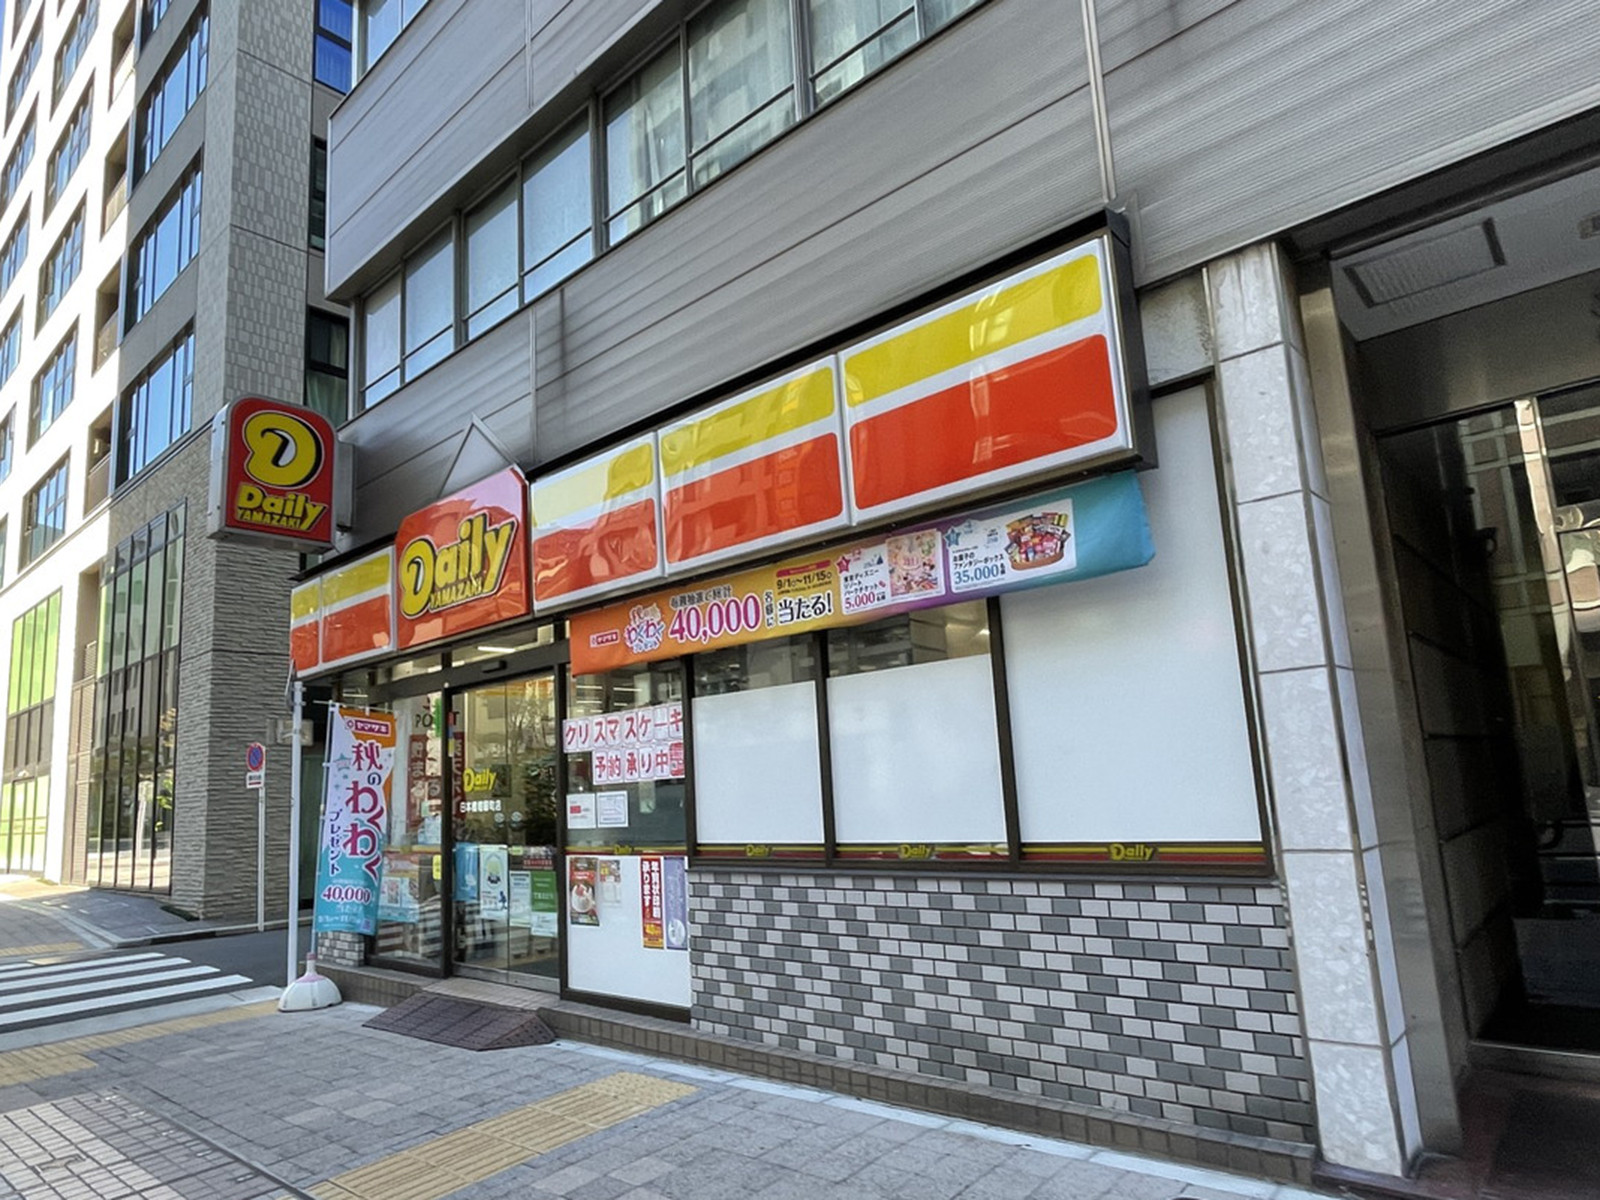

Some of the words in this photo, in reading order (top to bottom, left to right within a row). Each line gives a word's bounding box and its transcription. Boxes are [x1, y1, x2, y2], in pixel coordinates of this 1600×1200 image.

[236, 483, 327, 531] Daily
[236, 508, 301, 528] YAMAZAKI
[401, 513, 516, 618] Daily
[669, 594, 761, 642] 40,000
[778, 592, 832, 624] 当たる!
[355, 721, 389, 734] ヤマザキ
[565, 708, 683, 746] クリスマスケーキ
[595, 749, 669, 778] 予約承り中
[463, 767, 497, 792] Daily
[329, 810, 343, 876] プレゼント
[900, 844, 935, 859] Daily
[1110, 843, 1154, 861] Daily
[322, 886, 371, 904] 40,000
